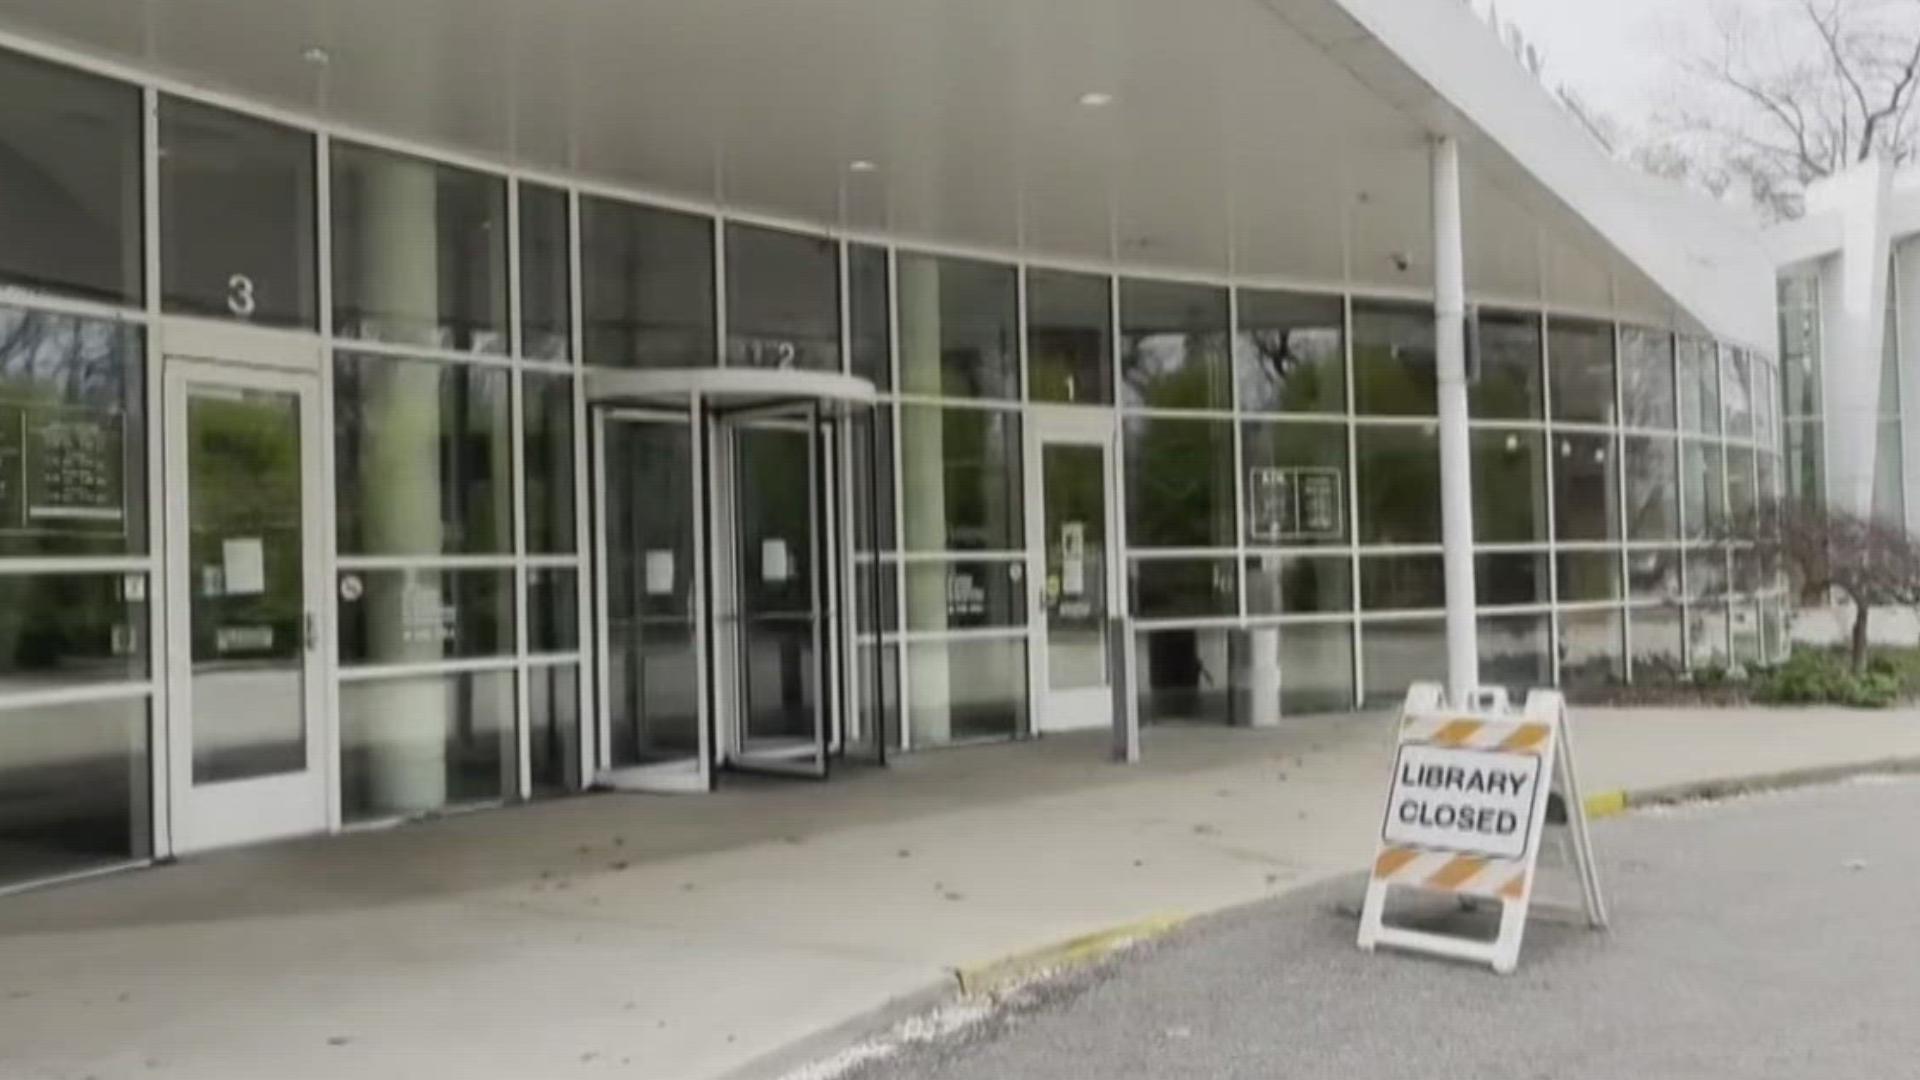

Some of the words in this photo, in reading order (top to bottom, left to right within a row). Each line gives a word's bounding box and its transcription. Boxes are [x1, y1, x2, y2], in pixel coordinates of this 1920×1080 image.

[228, 273, 255, 316] 3
[779, 341, 795, 371] 2
[1065, 375, 1075, 402] 1
[1401, 762, 1527, 796] LIBRARY
[1399, 798, 1518, 835] CLOSED
